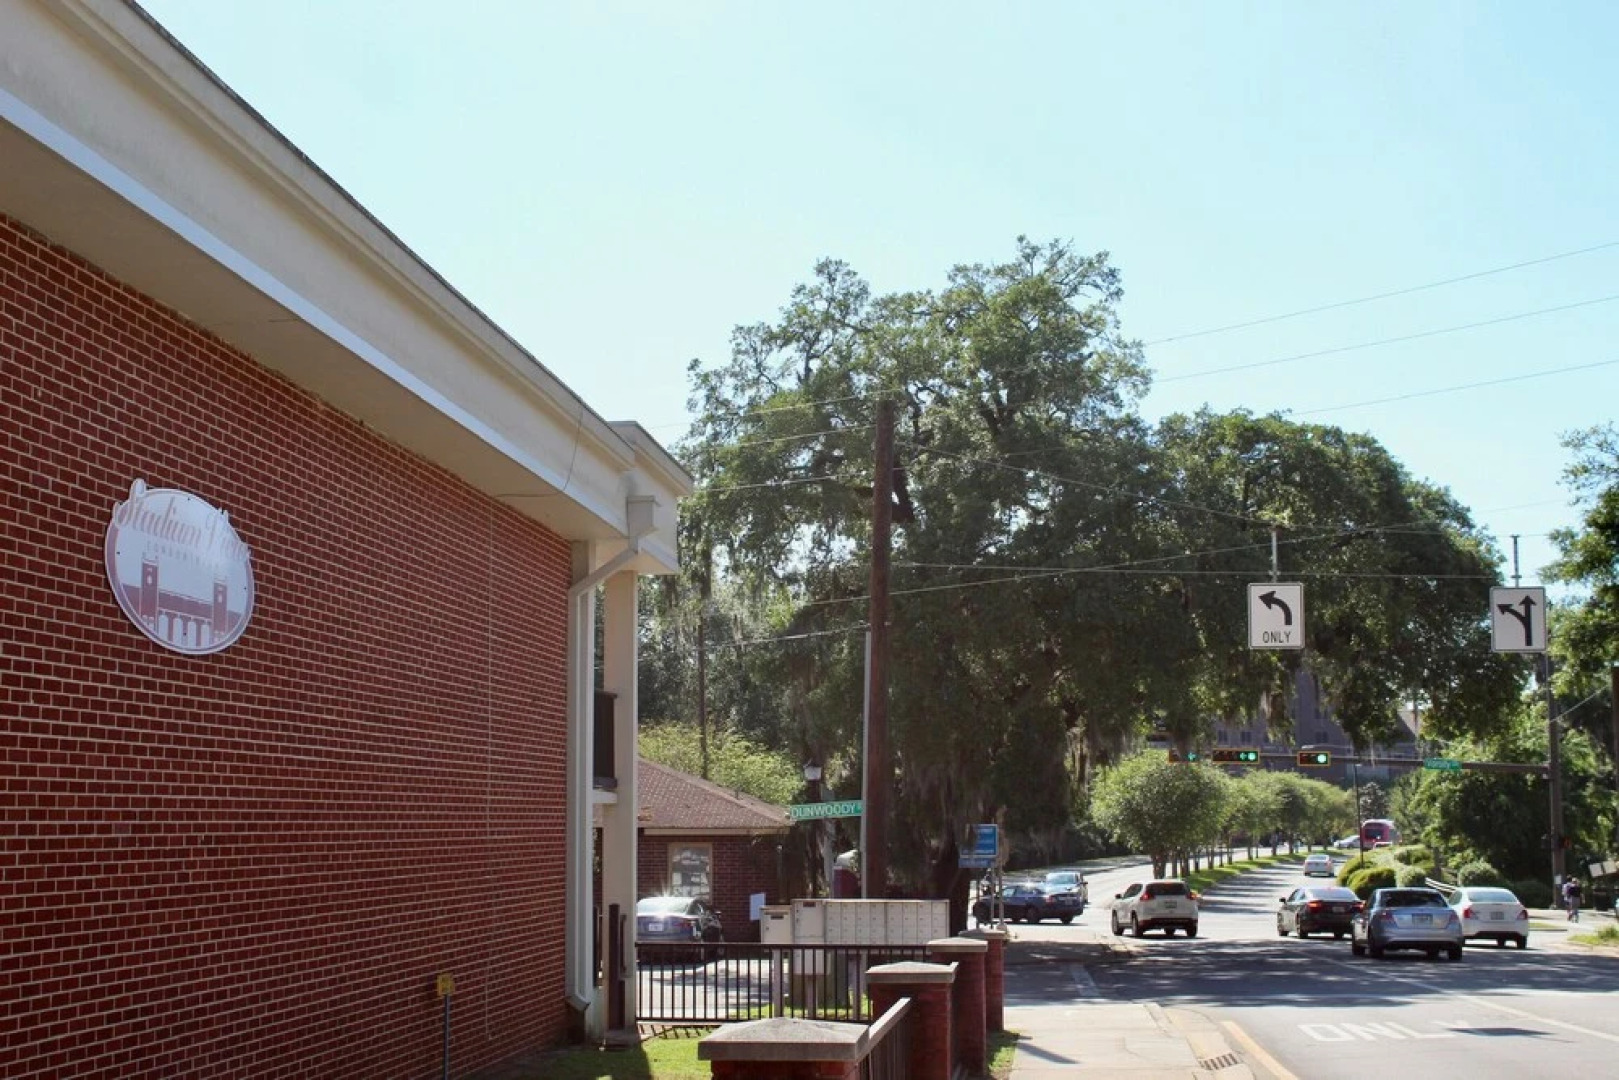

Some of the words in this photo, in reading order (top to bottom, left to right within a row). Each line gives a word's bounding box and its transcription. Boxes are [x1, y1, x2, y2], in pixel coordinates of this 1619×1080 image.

[1262, 630, 1291, 643] ONLY
[791, 802, 856, 818] DUNWOODY
[1297, 1020, 1483, 1041] ONLY
